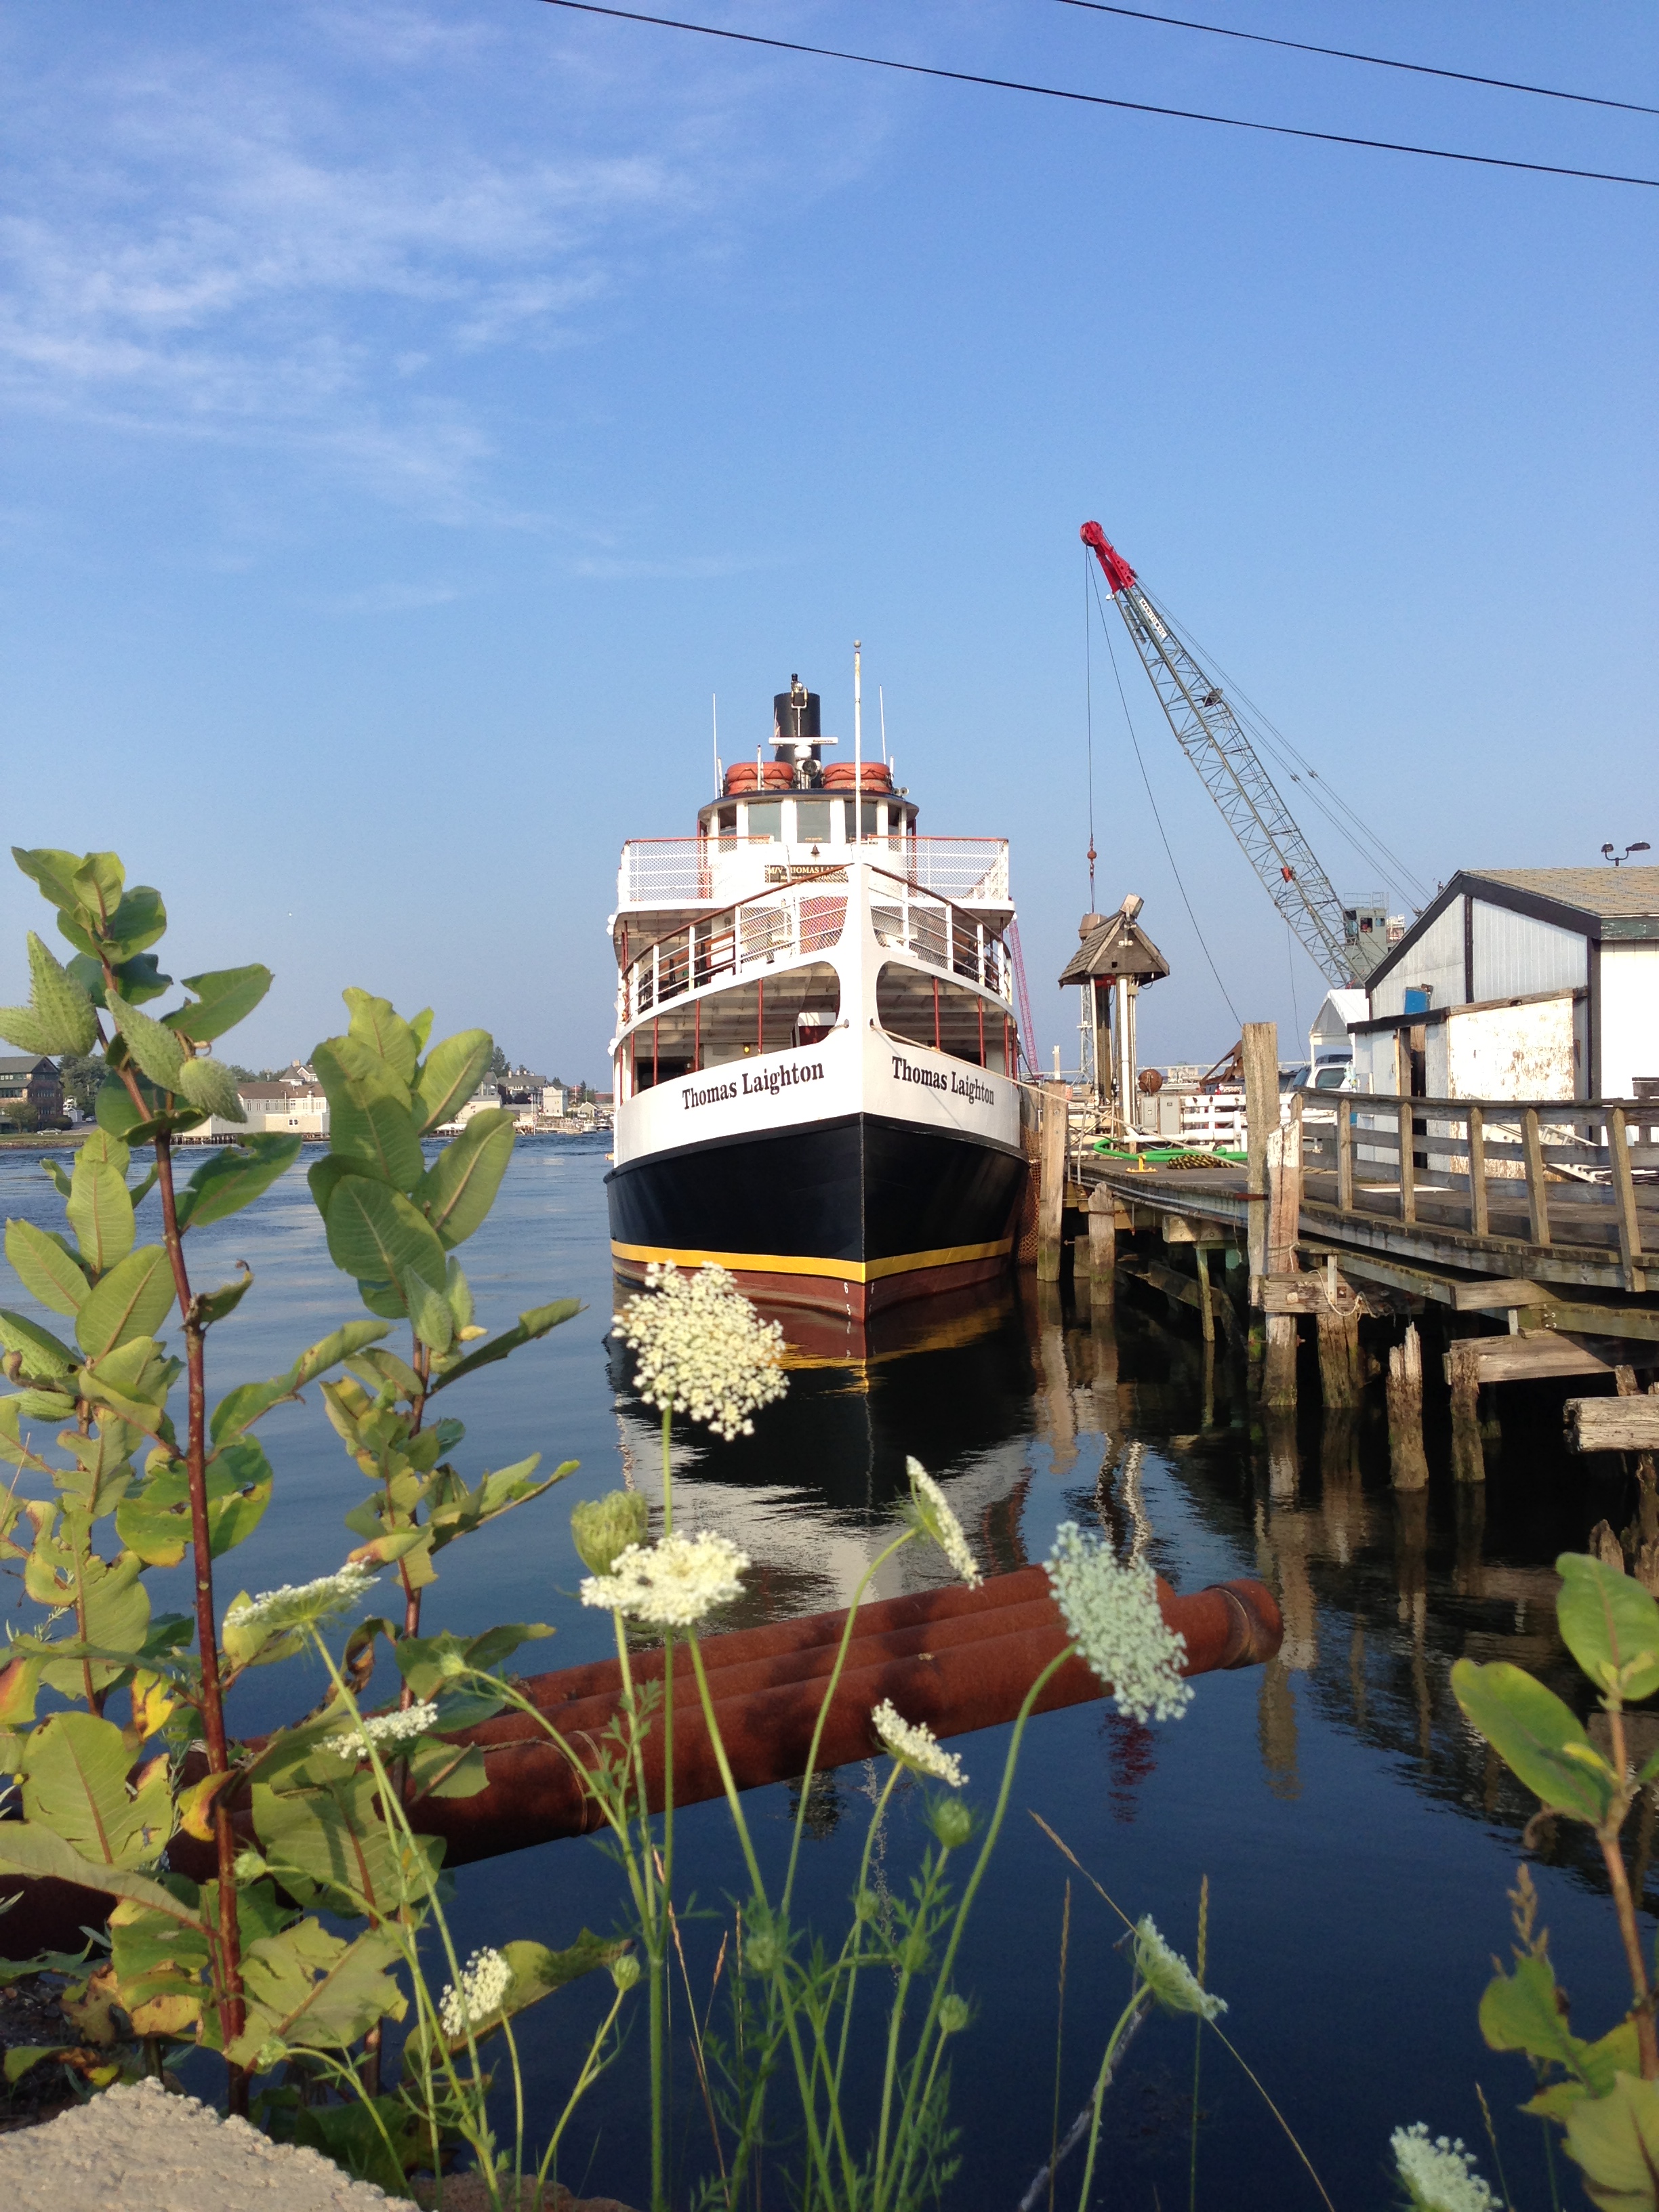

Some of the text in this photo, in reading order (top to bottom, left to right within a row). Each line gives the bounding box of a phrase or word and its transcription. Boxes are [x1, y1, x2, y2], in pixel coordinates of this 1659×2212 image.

[1141, 600, 1166, 636] MANITOWOC
[788, 866, 819, 874] HOMAS
[682, 1062, 825, 1110] Thomas Laighton
[892, 1055, 995, 1106] Thomas Laighton
[844, 1282, 848, 1294] 6
